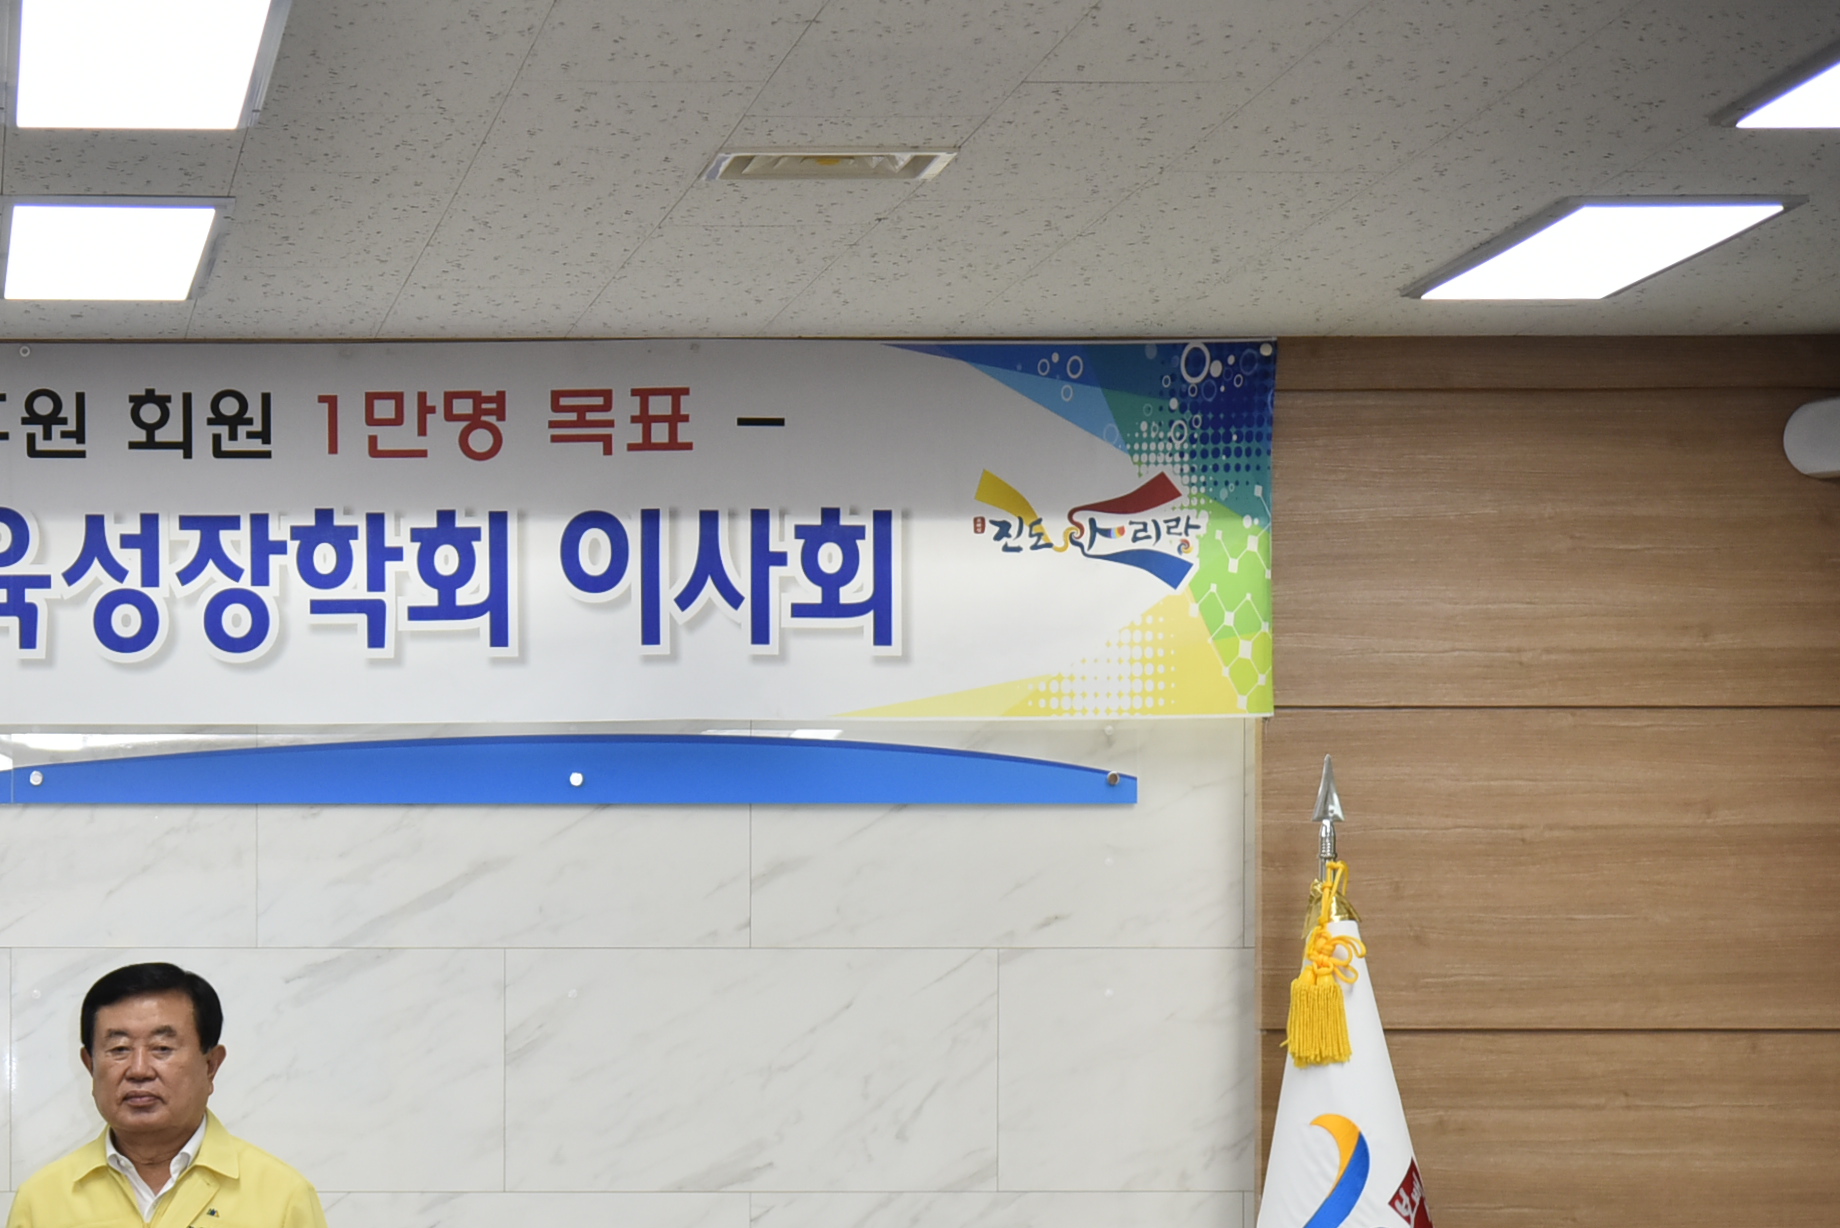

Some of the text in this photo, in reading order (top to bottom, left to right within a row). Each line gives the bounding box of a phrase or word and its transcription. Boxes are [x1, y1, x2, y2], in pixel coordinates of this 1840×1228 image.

[128, 388, 273, 459] 회원
[318, 389, 507, 462] 1만명
[547, 387, 695, 456] 목표
[560, 507, 894, 648] 이사회
